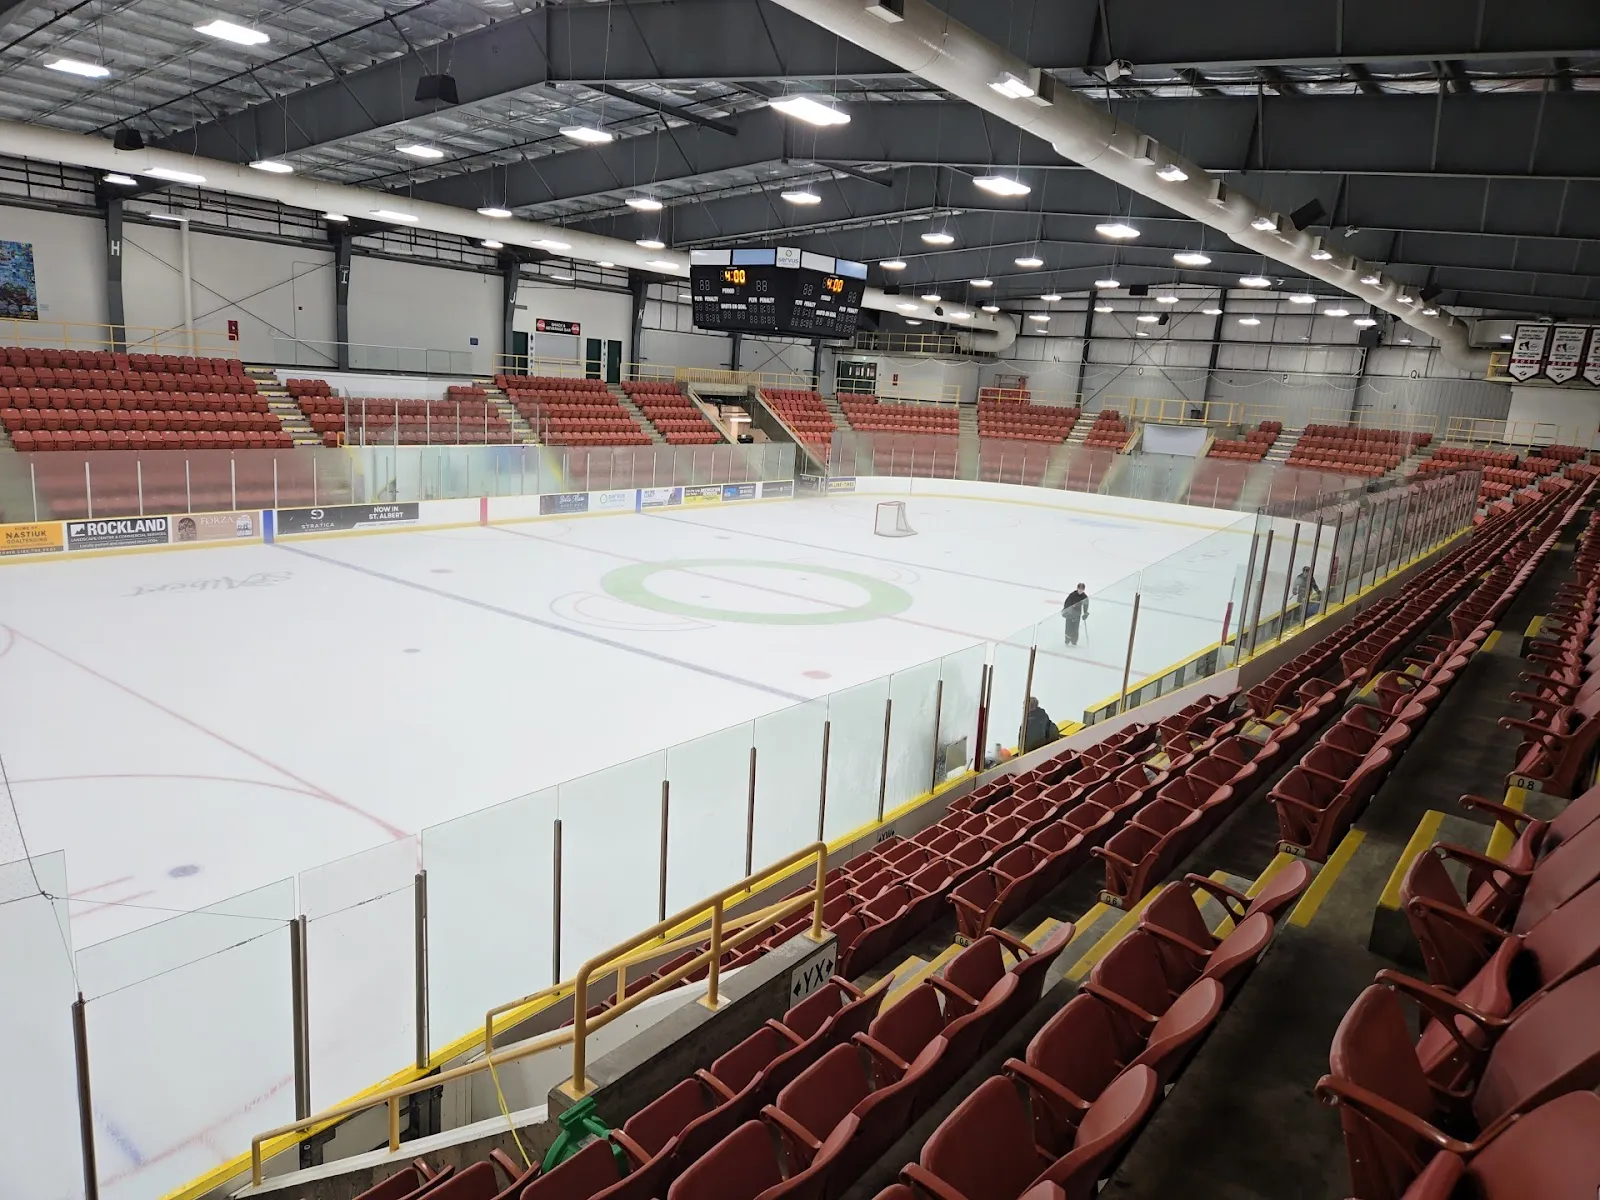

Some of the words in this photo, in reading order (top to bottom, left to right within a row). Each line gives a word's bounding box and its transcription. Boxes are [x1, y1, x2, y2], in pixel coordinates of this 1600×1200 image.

[111, 240, 119, 256] H
[341, 270, 348, 284] I
[725, 270, 746, 283] 4:00
[827, 279, 844, 293] 4:00
[510, 291, 516, 304] J
[637, 308, 644, 320] K
[1282, 374, 1289, 383] P
[1410, 369, 1418, 379] Q
[200, 515, 236, 525] FORZA
[380, 511, 404, 519] ALBERT
[86, 518, 166, 536] ROCKLAND
[301, 522, 336, 530] STRATICA
[5, 530, 47, 539] NASTIUK
[1518, 778, 1534, 790] 08
[1286, 845, 1299, 855] 07
[1106, 895, 1117, 906] 06
[804, 958, 826, 993] YX
